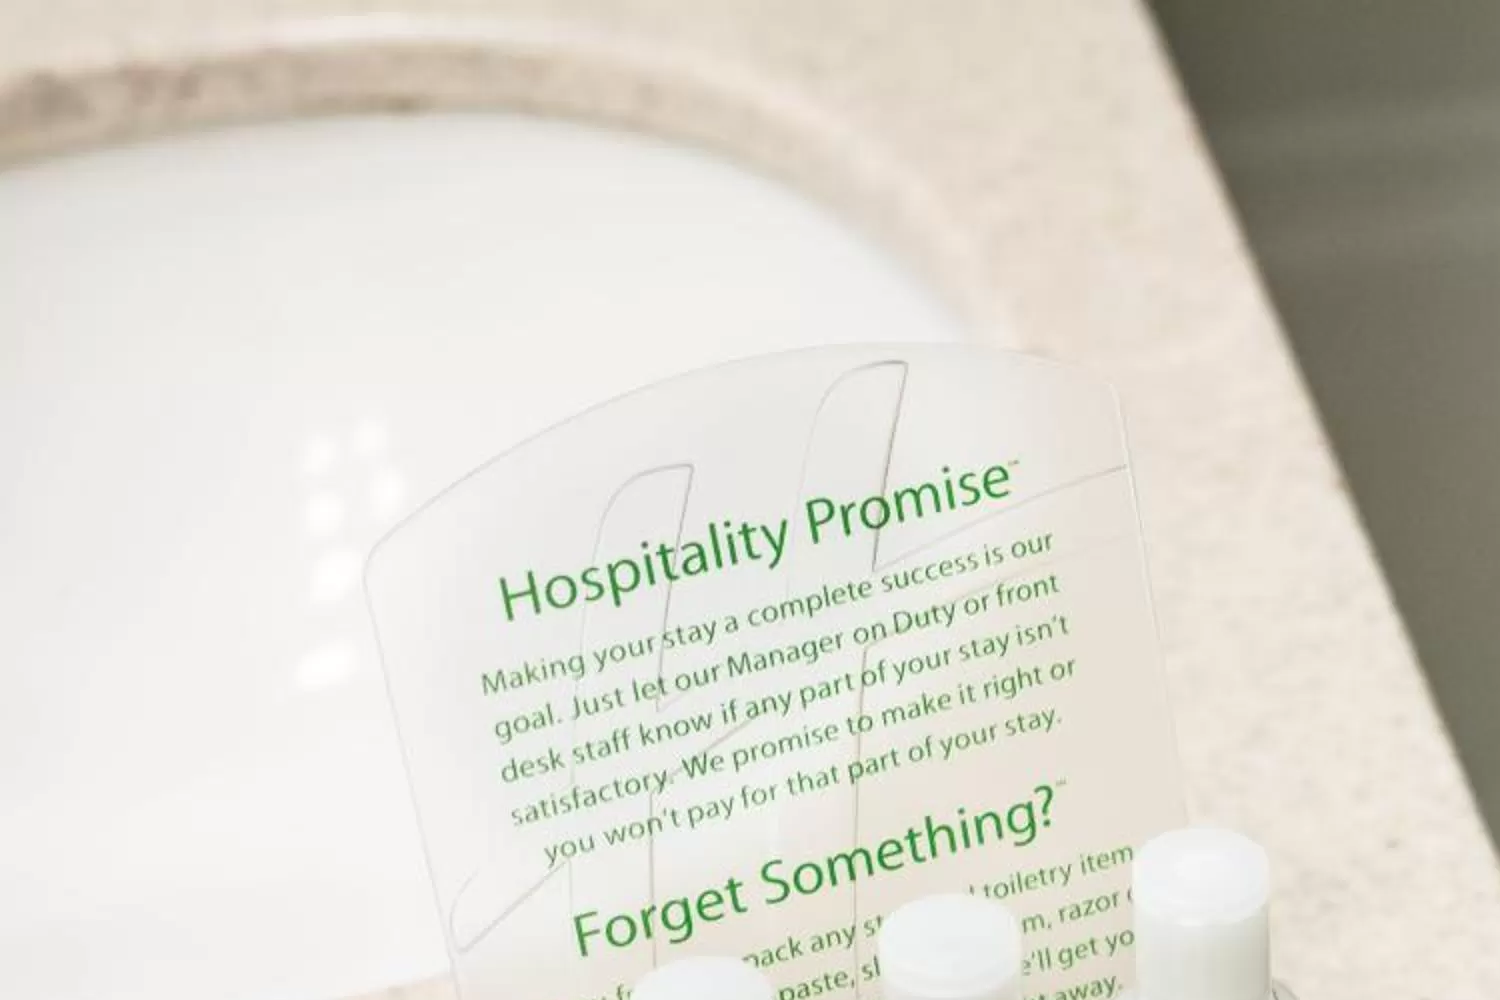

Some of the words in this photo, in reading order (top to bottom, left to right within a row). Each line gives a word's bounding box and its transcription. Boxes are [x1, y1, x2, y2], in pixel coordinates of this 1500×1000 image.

[481, 654, 586, 697] Making
[592, 635, 656, 673] your
[662, 620, 718, 650] stay
[724, 614, 740, 634] a
[747, 579, 873, 627] complete
[880, 552, 980, 593] success
[984, 543, 1004, 567] is
[1010, 532, 1055, 559] our
[499, 518, 788, 622] Hospitality
[806, 464, 1010, 545] Promise
[494, 701, 564, 746] goal.
[571, 687, 626, 721] Just
[631, 675, 668, 702] let
[674, 663, 721, 692] our
[726, 630, 845, 679] Manager
[852, 620, 888, 646] on
[892, 601, 956, 637] Duty
[963, 593, 991, 617] or
[996, 574, 1061, 607] front
[500, 747, 566, 784] desk
[571, 726, 632, 766] staff
[638, 711, 714, 748] know
[719, 698, 740, 726] if
[744, 688, 793, 721] any
[799, 671, 856, 708] part
[860, 659, 888, 688] of
[891, 646, 953, 685] your
[958, 631, 1011, 662] stay
[1014, 614, 1070, 647] isn't
[510, 768, 676, 827] satisfactory.
[680, 752, 726, 780] We
[731, 722, 840, 773] promise
[846, 714, 874, 737] to
[880, 691, 952, 728] make
[957, 683, 977, 706] it
[982, 667, 1044, 701] right
[1049, 658, 1077, 682] or
[543, 834, 596, 869] you
[602, 806, 682, 847] won't
[686, 795, 736, 830] pay
[739, 783, 780, 810] for
[786, 764, 841, 797] that
[847, 748, 902, 785] part
[908, 734, 933, 764] of
[938, 723, 1000, 761] your
[1004, 706, 1063, 737] stay.
[573, 875, 750, 958] Forget
[758, 783, 1056, 906] Something?
[809, 924, 857, 951] any
[983, 862, 1073, 899] toiletry
[1079, 844, 1134, 876] item
[1056, 936, 1099, 971] get
[1104, 928, 1136, 957] yo
[1057, 890, 1121, 925] razor
